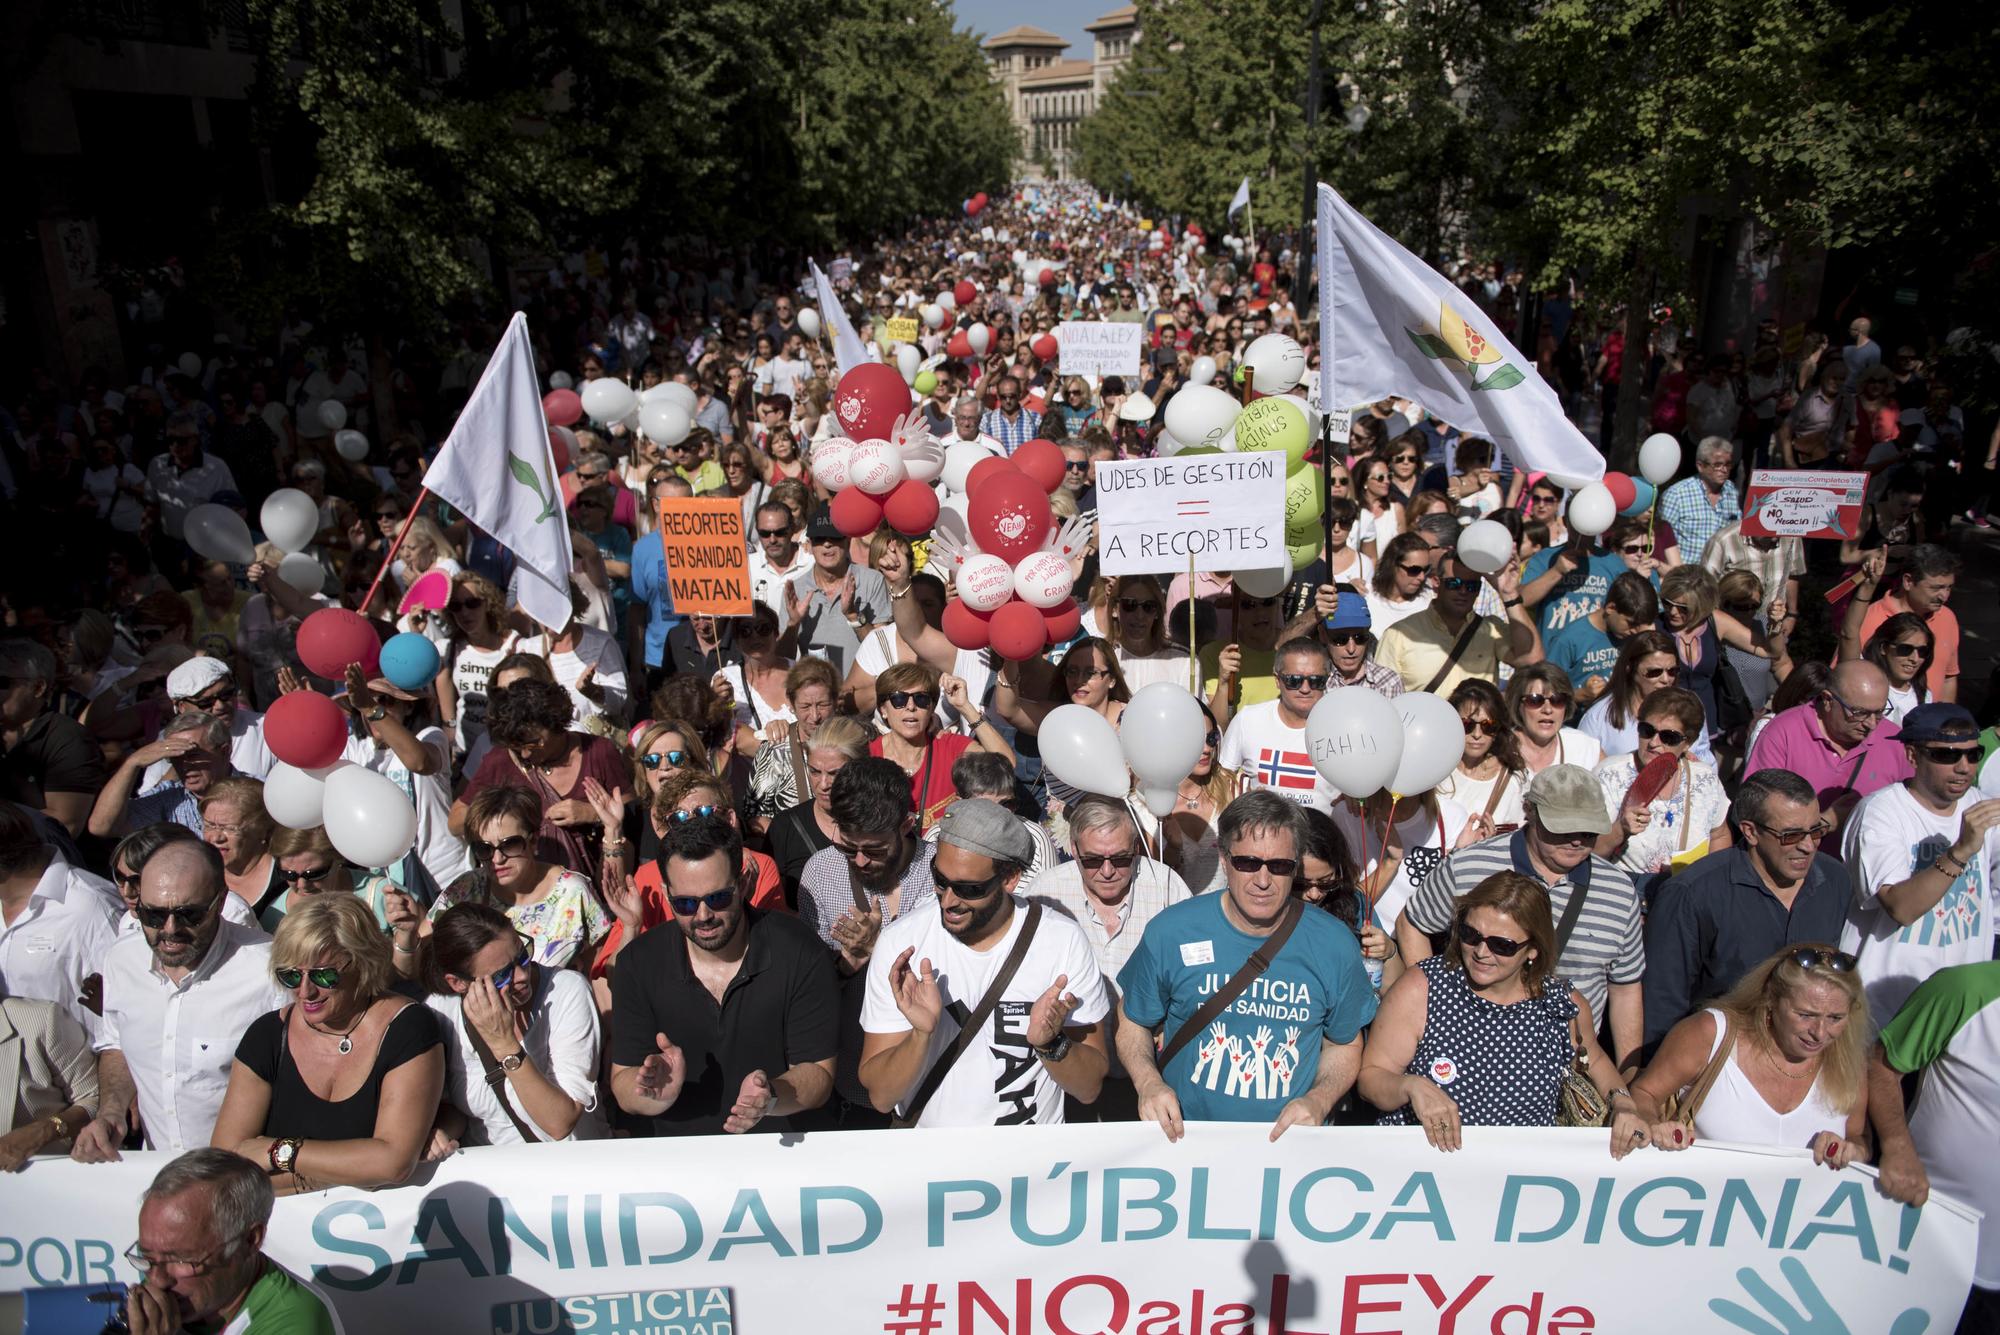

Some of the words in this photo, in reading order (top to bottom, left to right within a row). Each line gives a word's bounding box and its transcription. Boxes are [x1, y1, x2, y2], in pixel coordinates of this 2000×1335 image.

[1154, 466, 1175, 486] DE
[1183, 457, 1273, 485] GESTIÓN
[663, 512, 739, 536] RECORTES
[1105, 535, 1126, 559] A
[1140, 526, 1268, 557] RECORTES
[667, 546, 685, 569] EN
[687, 546, 743, 569] SANIDAD
[672, 578, 748, 601] MATAN.
[459, 680, 470, 691] is
[1236, 999, 1310, 1022] SANIDAD
[310, 1186, 884, 1292] SANIDAD
[927, 1161, 1457, 1249] PÚBLICA
[1493, 1174, 1924, 1275] DIGNA!
[495, 1287, 731, 1335] JUSTICIA
